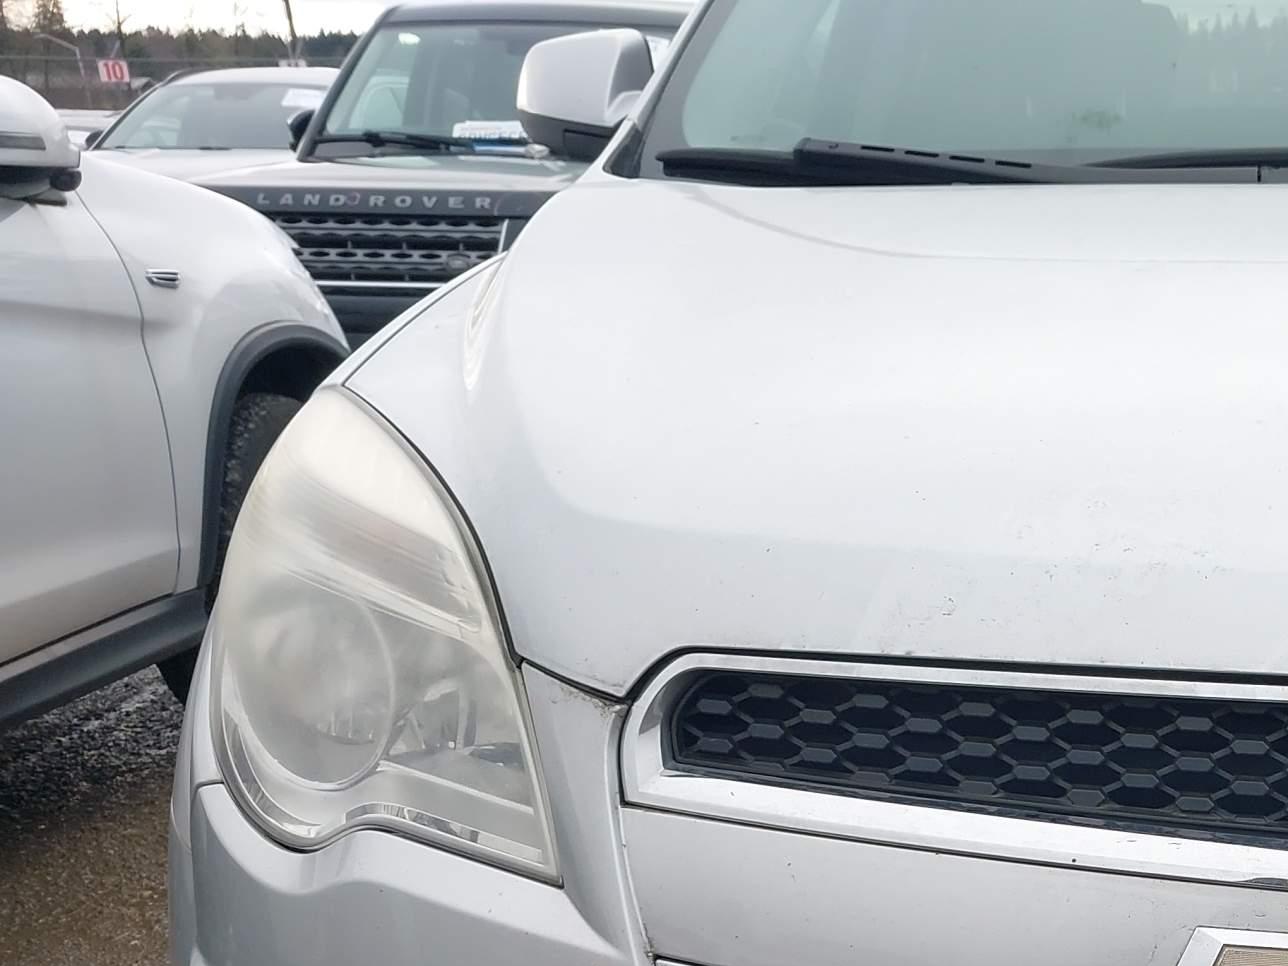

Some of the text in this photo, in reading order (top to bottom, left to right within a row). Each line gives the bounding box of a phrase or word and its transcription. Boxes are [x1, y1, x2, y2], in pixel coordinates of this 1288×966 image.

[103, 63, 124, 81] 10
[256, 193, 492, 209] LAND ROVER
